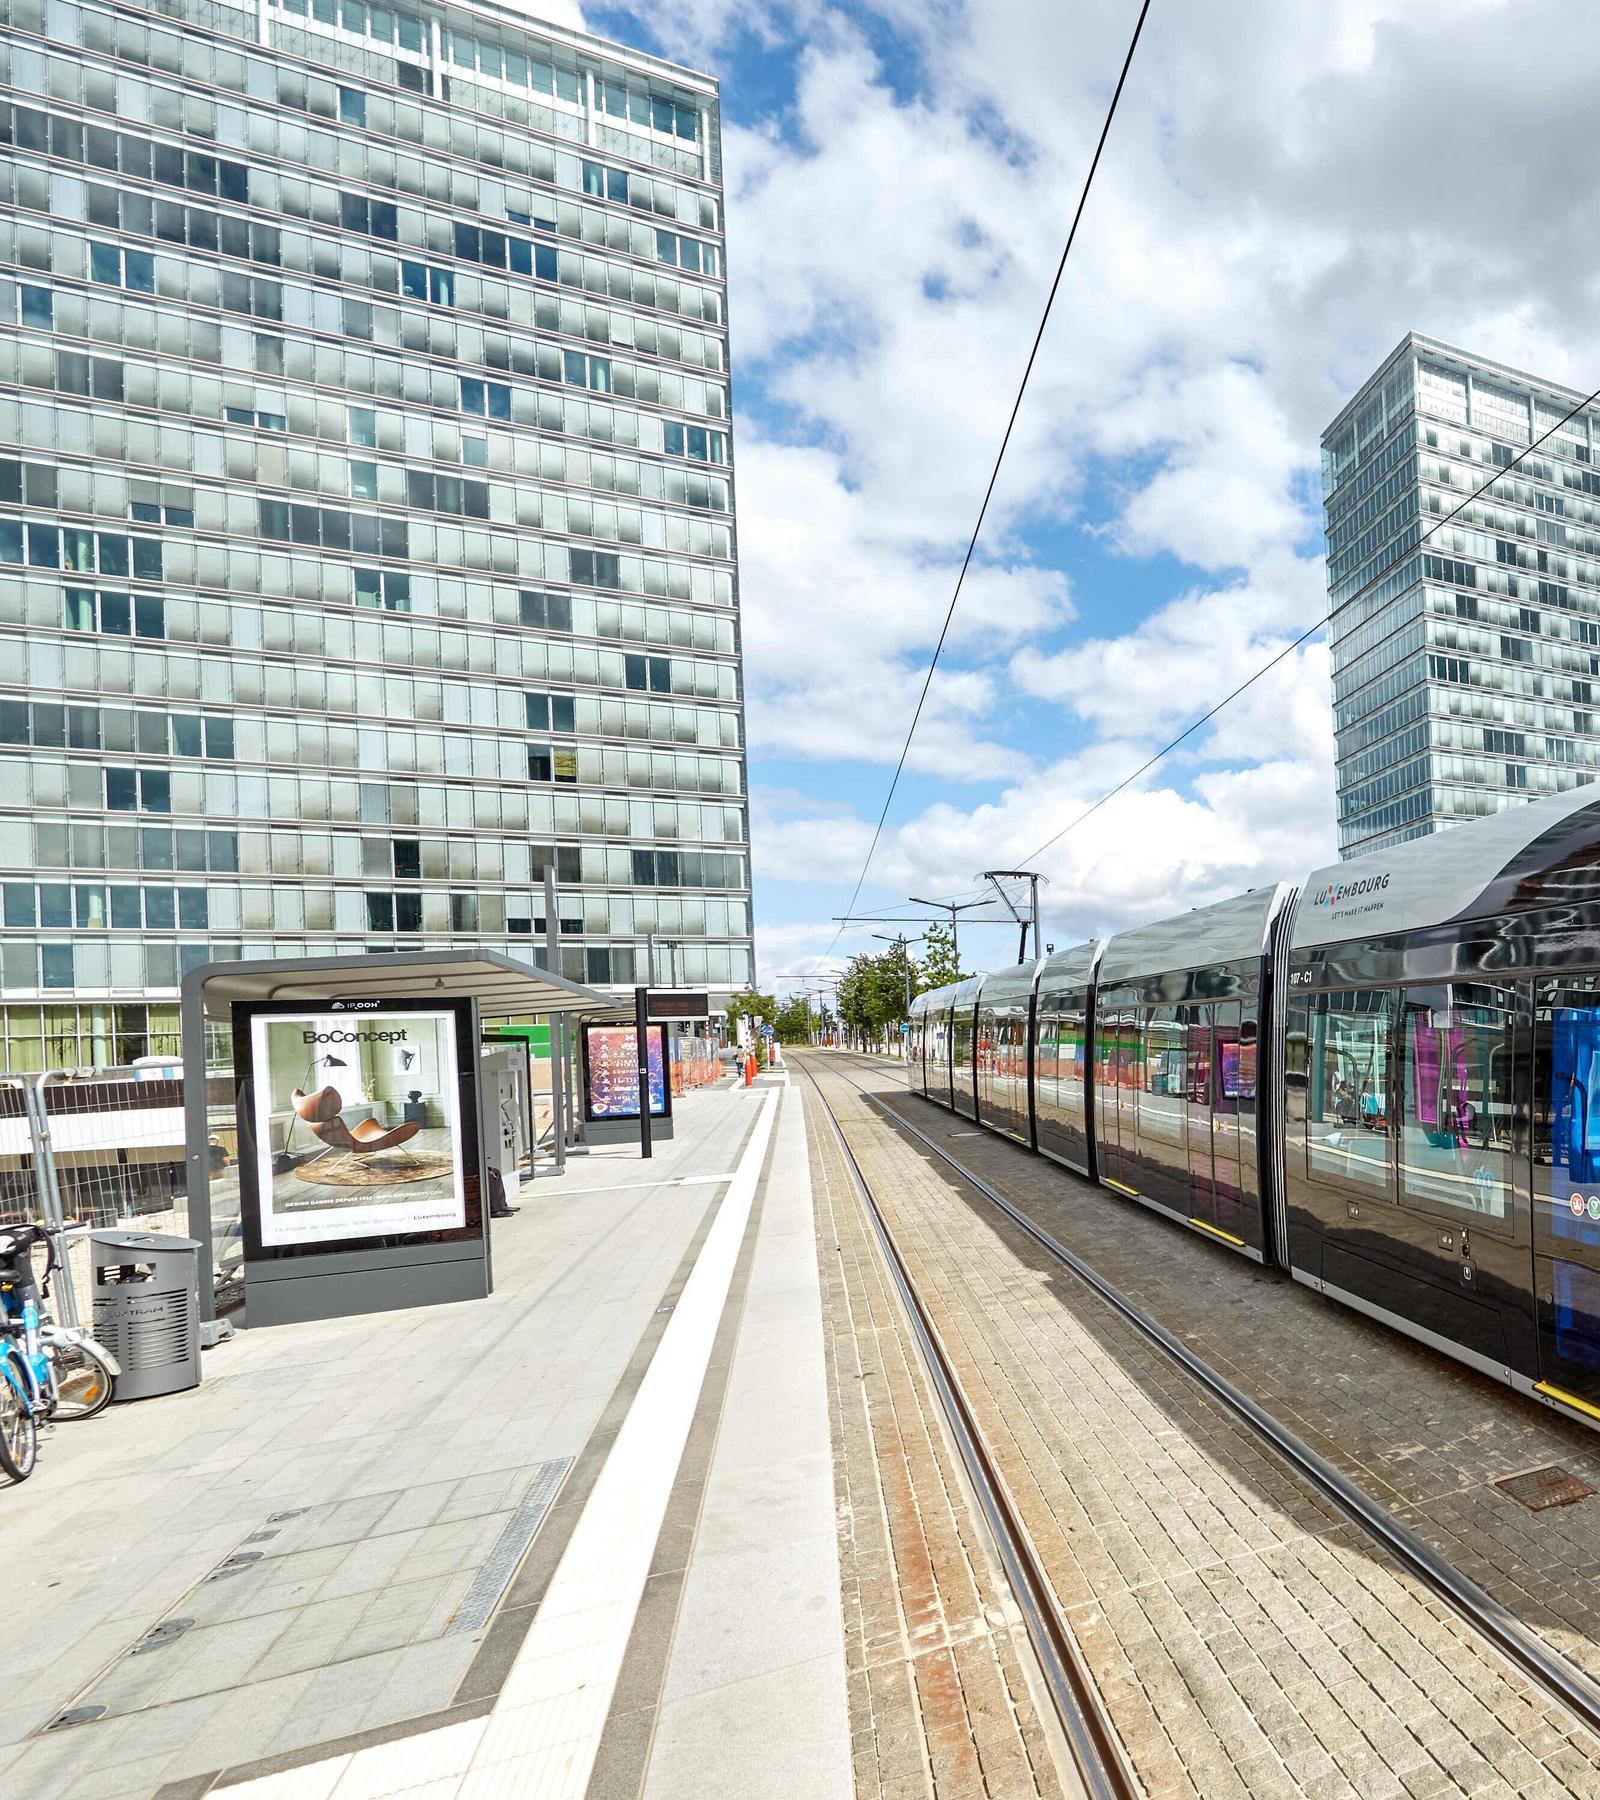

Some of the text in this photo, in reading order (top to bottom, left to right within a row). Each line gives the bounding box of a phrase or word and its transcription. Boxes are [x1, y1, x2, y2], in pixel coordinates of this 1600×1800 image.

[1314, 873, 1390, 907] LUXEMBOURG
[1344, 909, 1357, 917] MAKE
[1363, 902, 1384, 912] HAPPEN
[302, 1029, 408, 1044] BoConcept
[413, 1212, 457, 1221] Luxembourg
